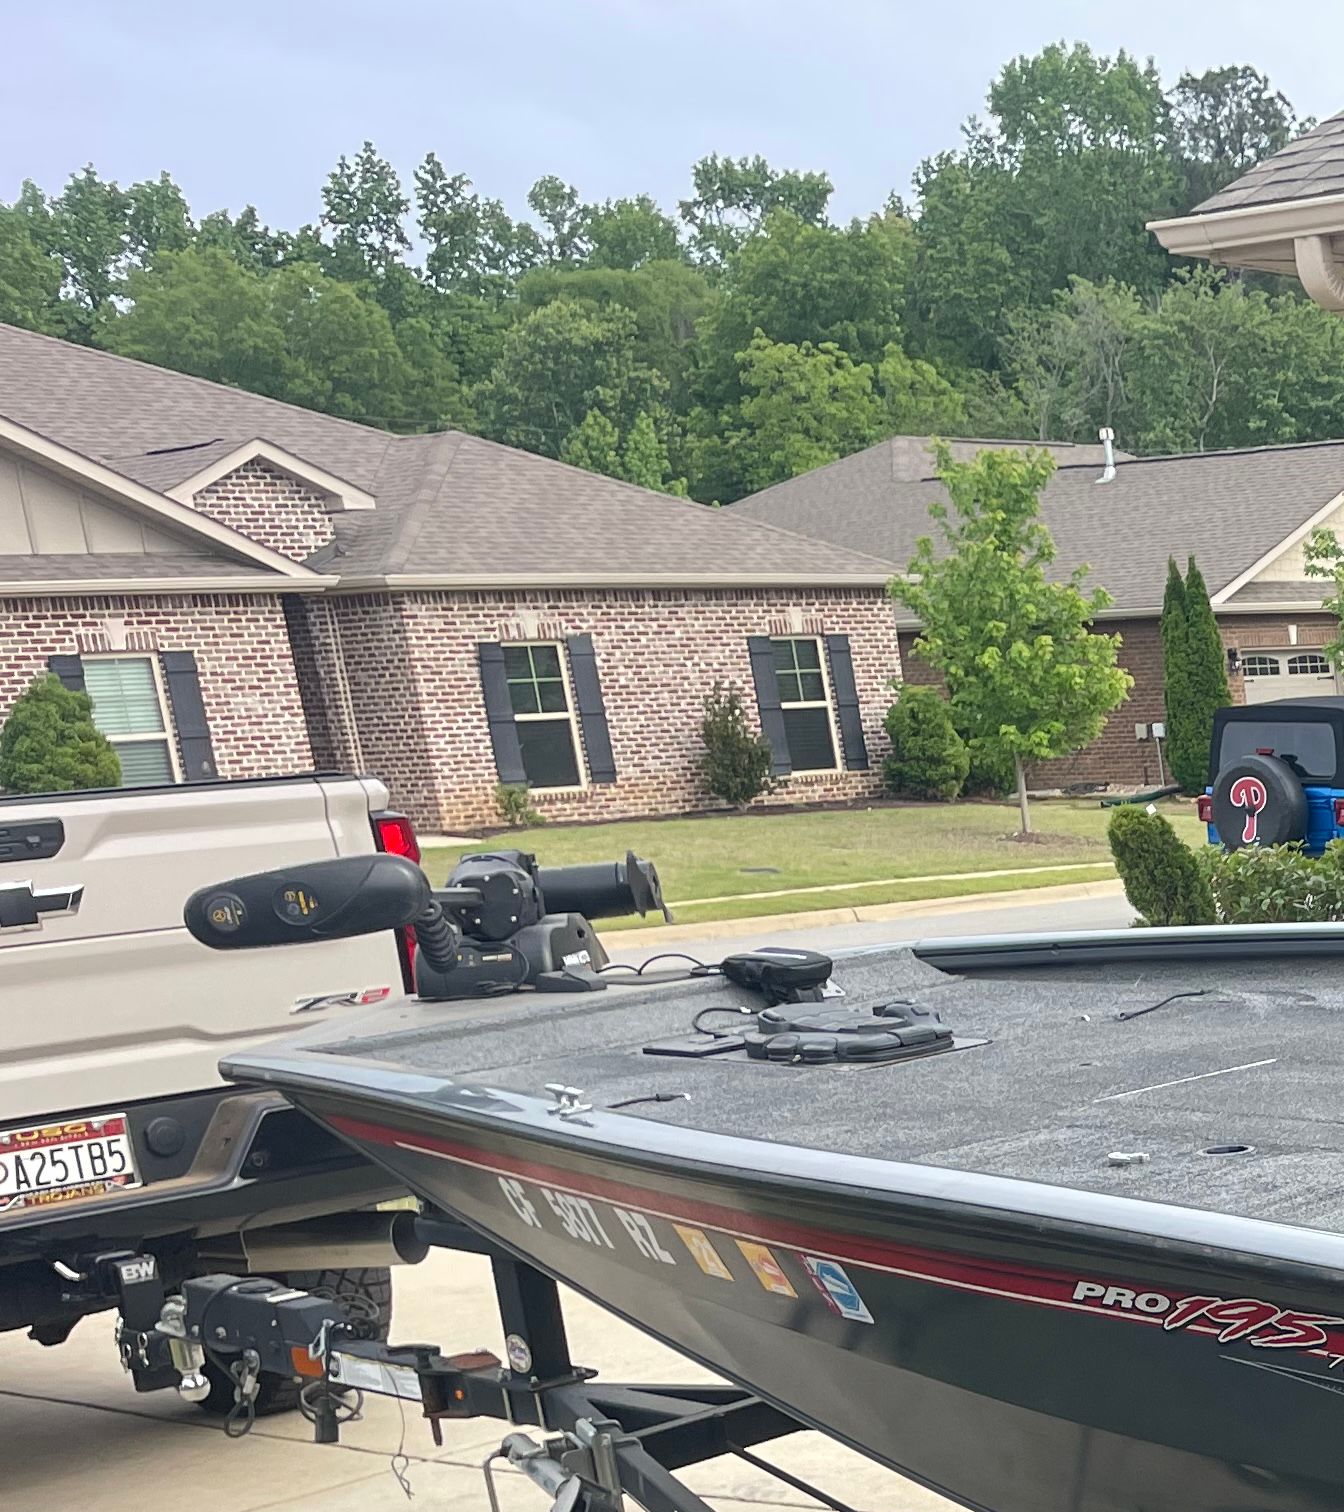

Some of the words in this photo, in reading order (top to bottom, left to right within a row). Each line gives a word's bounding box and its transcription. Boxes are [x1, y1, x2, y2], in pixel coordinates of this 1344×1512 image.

[498, 1176, 542, 1229] CF
[613, 1207, 677, 1265] RZ
[1072, 1281, 1171, 1314] PRO
